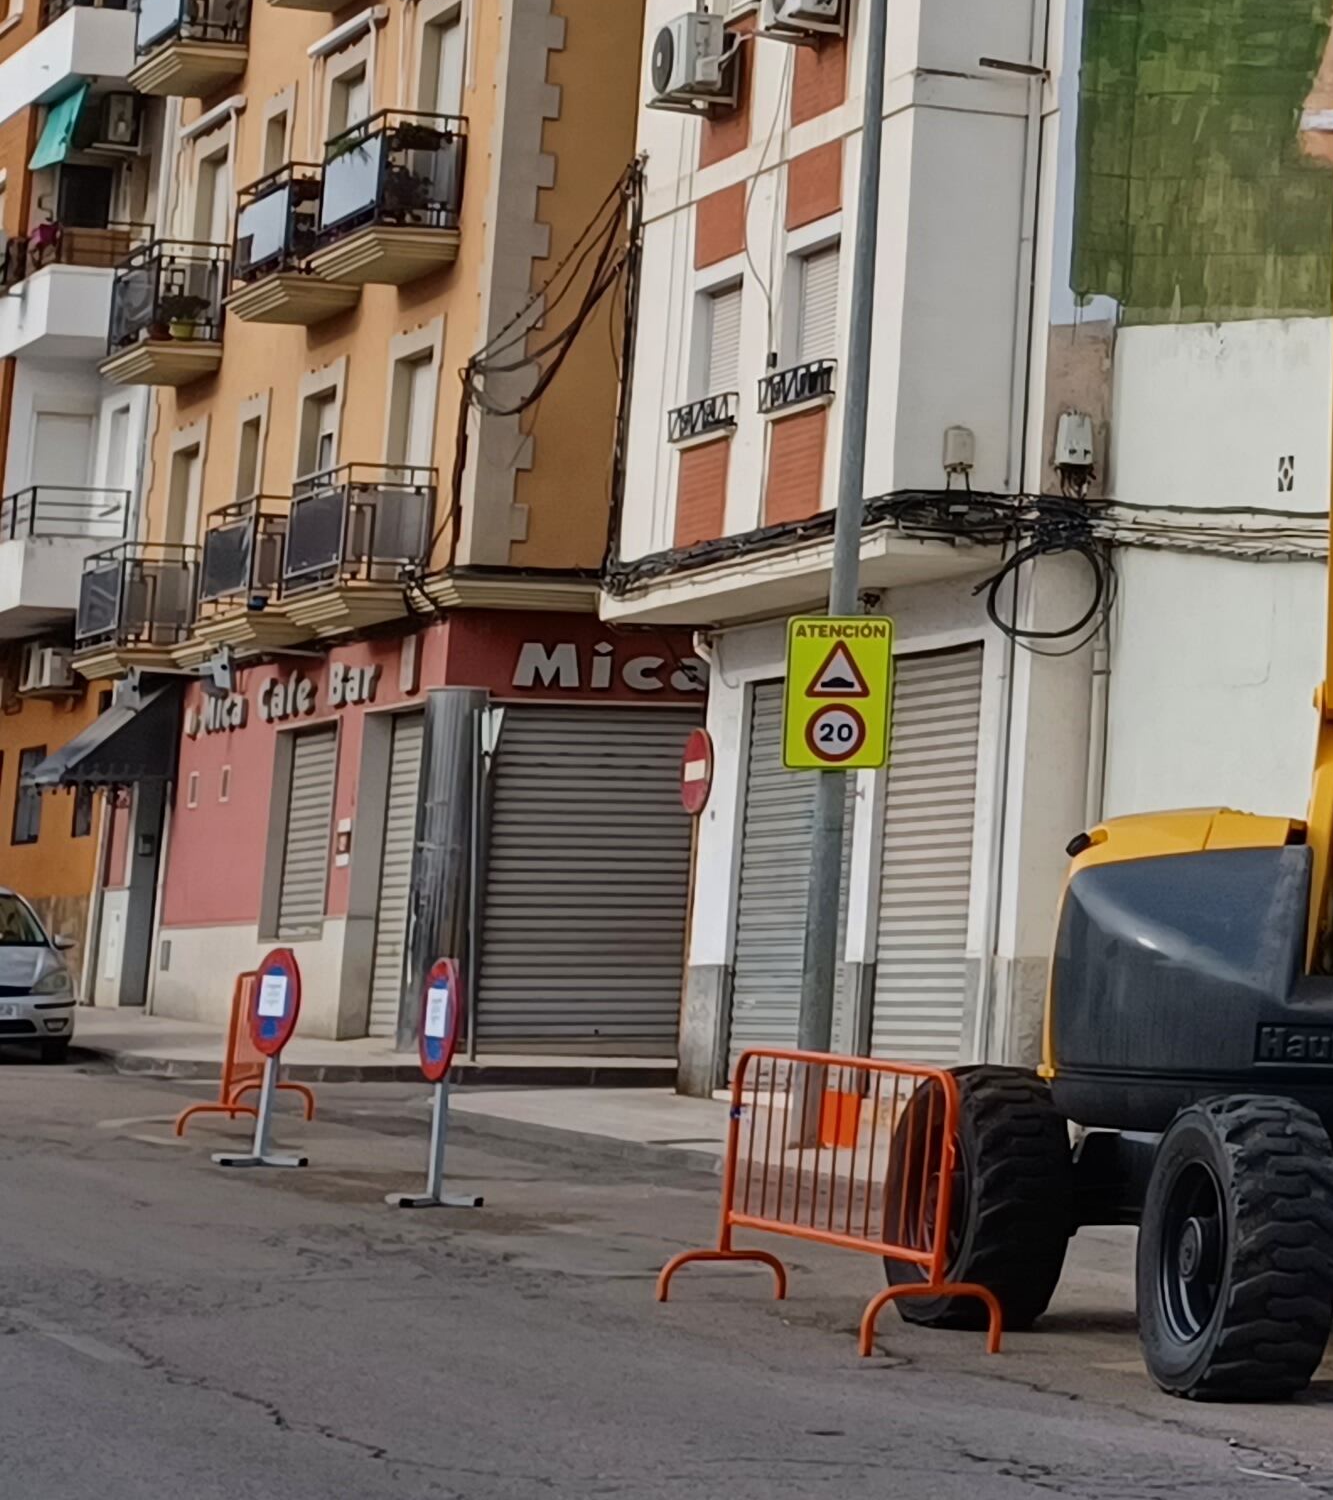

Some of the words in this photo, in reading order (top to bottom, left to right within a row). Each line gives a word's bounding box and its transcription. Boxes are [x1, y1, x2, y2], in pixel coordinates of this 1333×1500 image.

[796, 623, 886, 638] ATENCIÓN
[512, 641, 710, 691] Mica
[328, 662, 379, 707] Bar
[819, 723, 853, 742] 20
